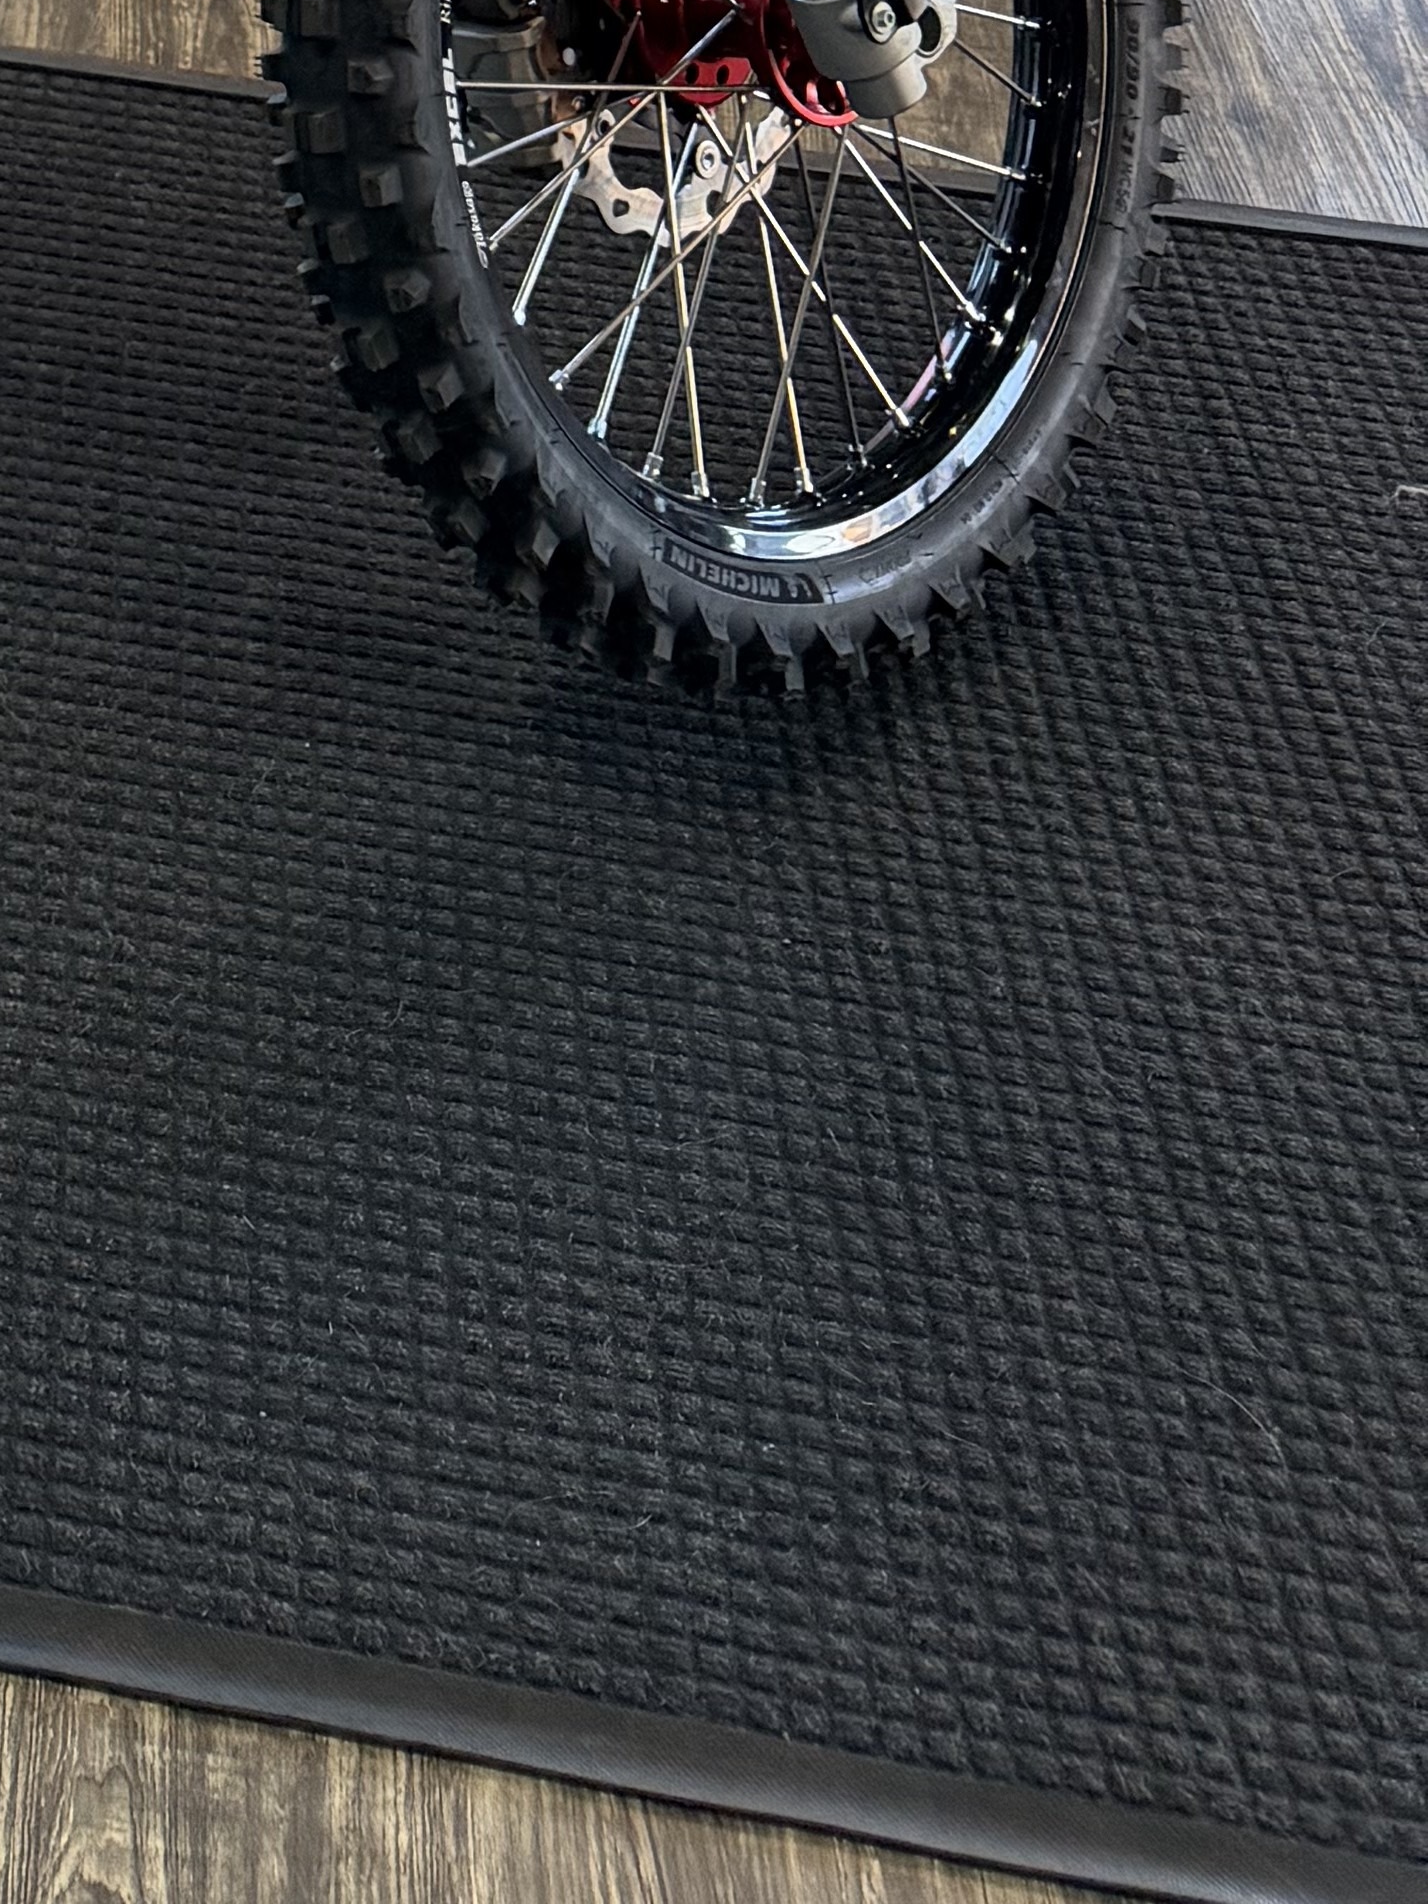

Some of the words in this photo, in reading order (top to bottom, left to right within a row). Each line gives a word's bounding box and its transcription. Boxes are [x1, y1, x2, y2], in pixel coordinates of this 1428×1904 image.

[1124, 17, 1141, 101] 90/90
[441, 48, 469, 168] EXCEL
[670, 543, 781, 598] MICHELIN
